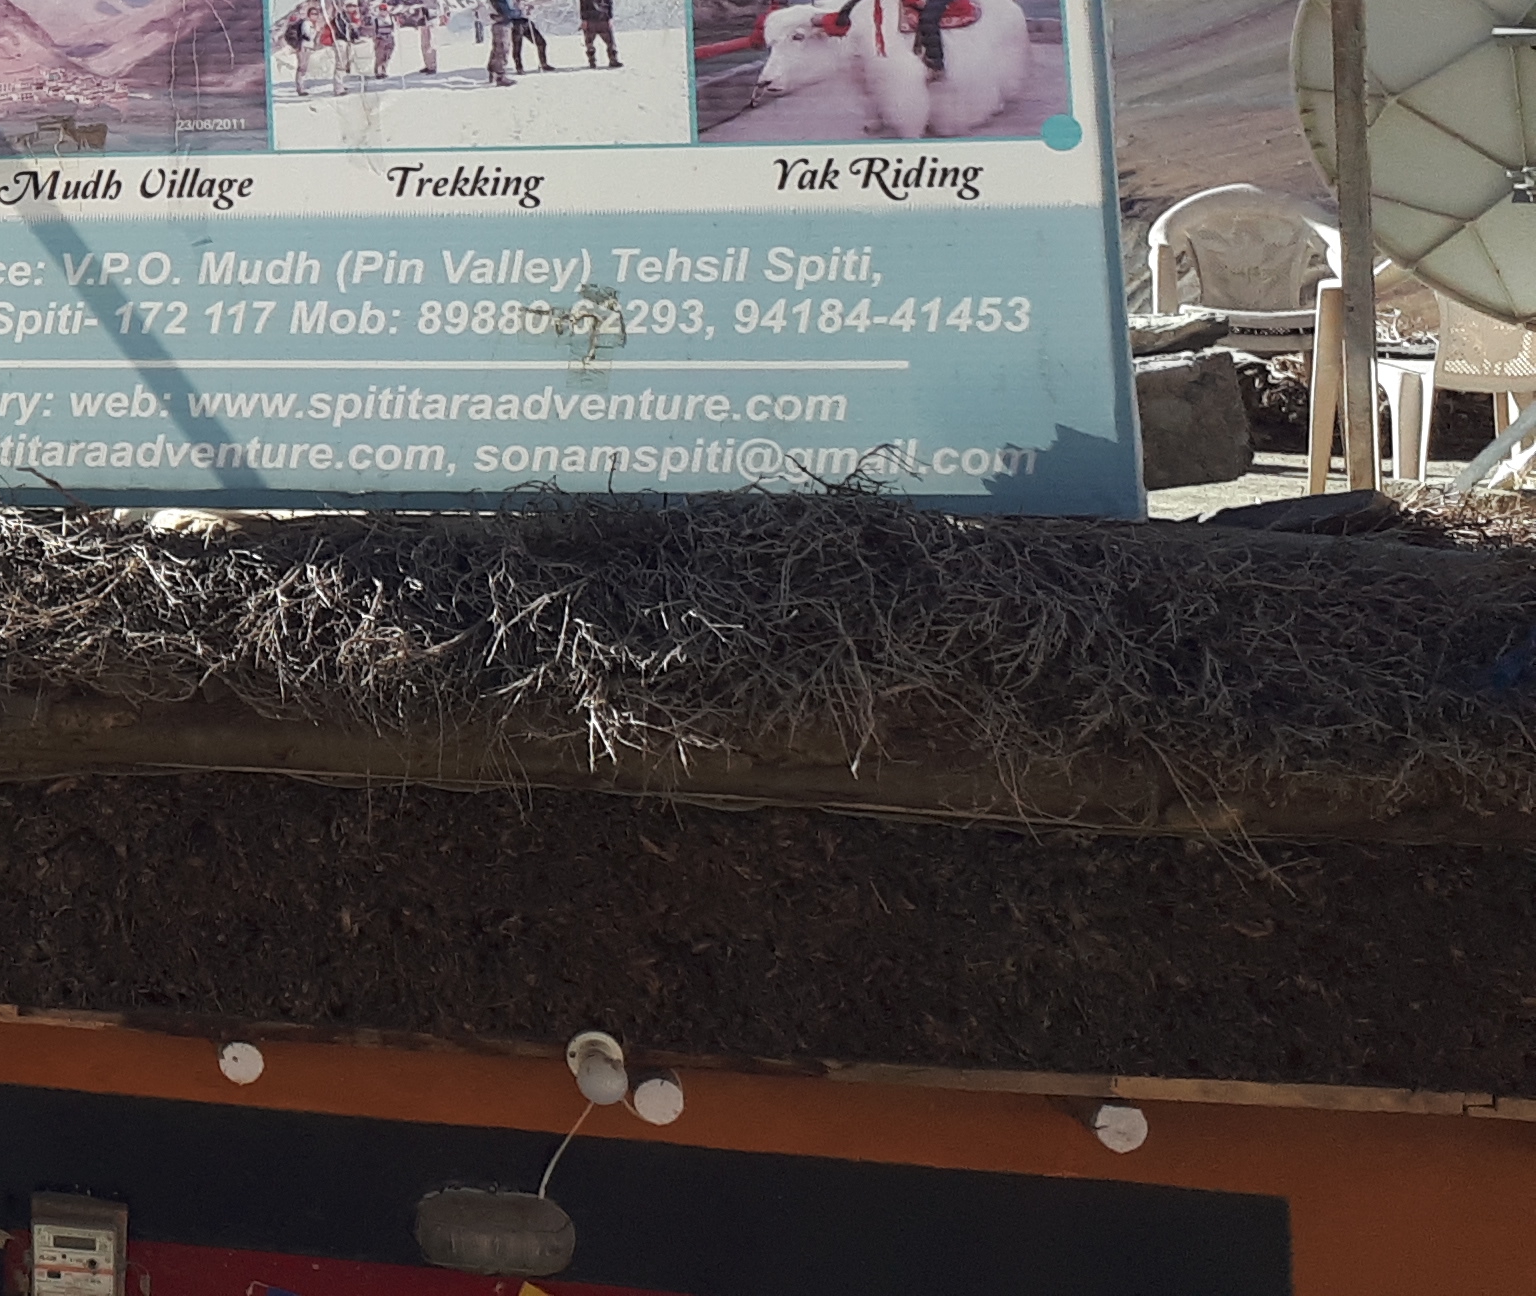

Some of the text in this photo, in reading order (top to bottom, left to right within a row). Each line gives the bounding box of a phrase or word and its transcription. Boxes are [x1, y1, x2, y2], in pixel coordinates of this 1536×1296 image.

[139, 167, 254, 210] Village
[386, 161, 545, 208] Trekking
[773, 156, 983, 201] Yak Riding
[62, 253, 181, 286] V.P.O.
[198, 251, 322, 285] Mudh
[336, 252, 425, 292] (Pin
[441, 248, 592, 295] Valley)
[611, 247, 748, 283] Tehsil
[763, 246, 883, 289] Spiti,
[116, 301, 188, 335] 172
[203, 300, 275, 334] 117
[289, 300, 400, 336] Mob:
[733, 296, 1031, 334] 94184-41453
[70, 384, 170, 418] web:
[188, 383, 847, 423] www.spititaraadventure.com
[473, 437, 1038, 483] sonamspiti@gmail.com
